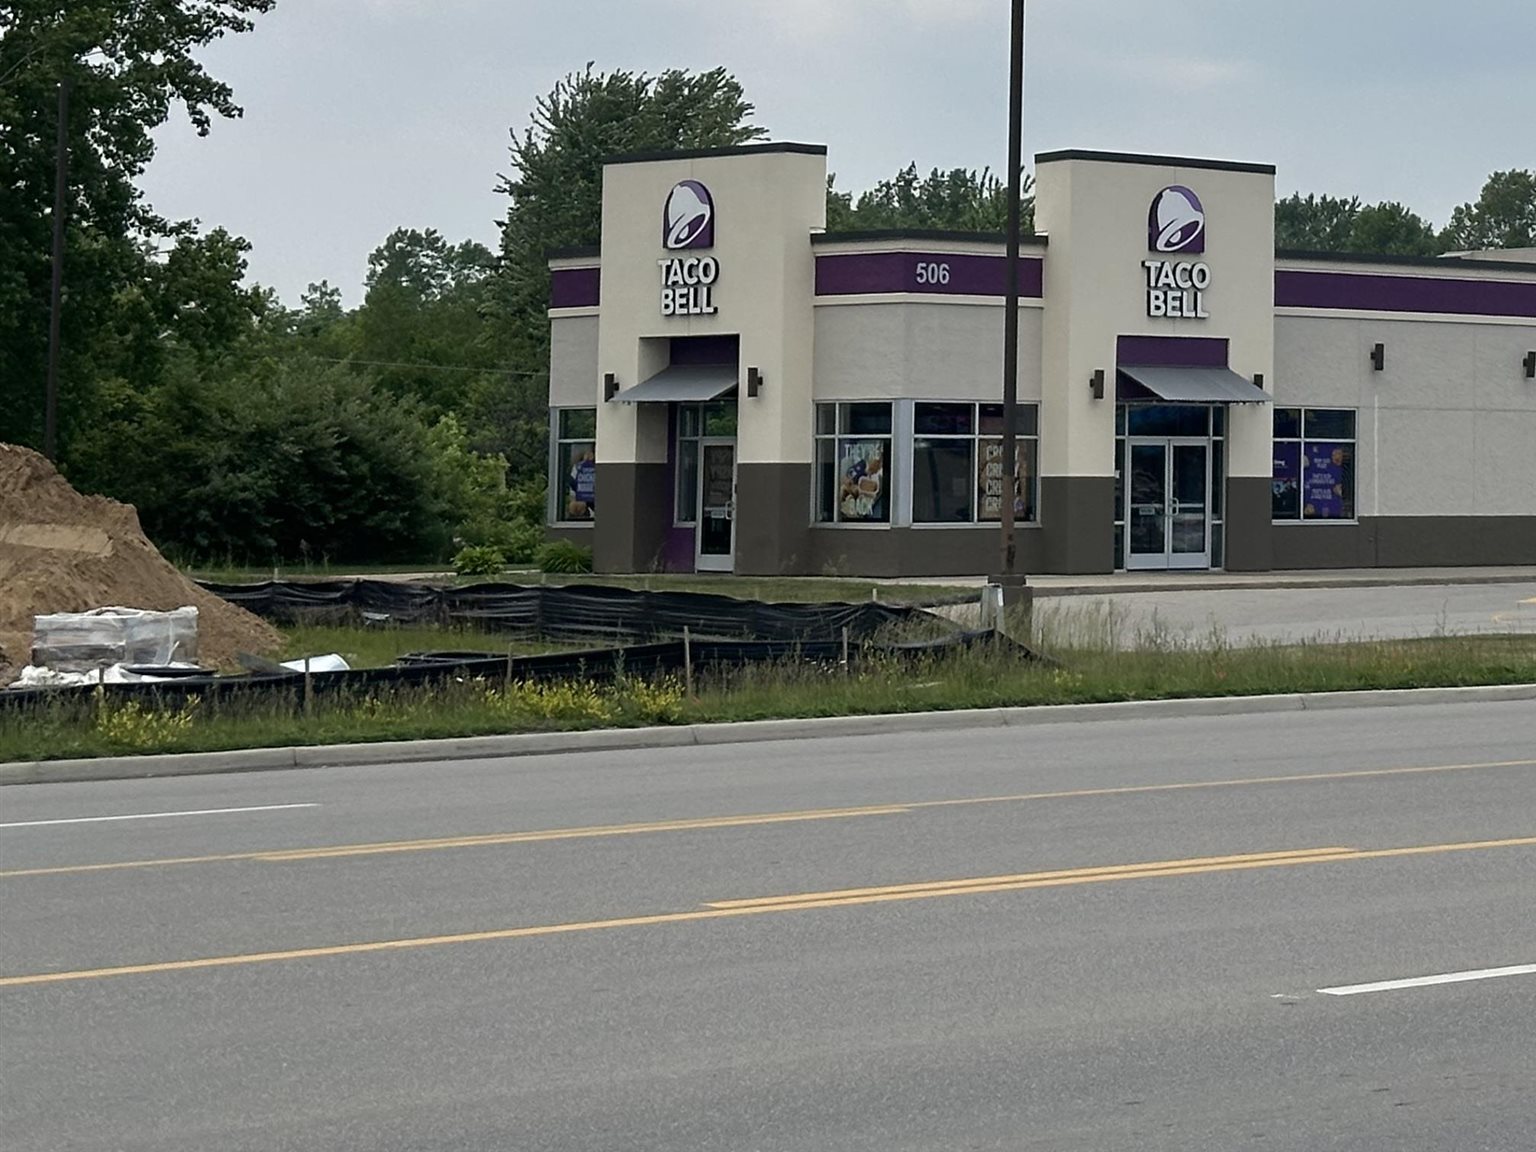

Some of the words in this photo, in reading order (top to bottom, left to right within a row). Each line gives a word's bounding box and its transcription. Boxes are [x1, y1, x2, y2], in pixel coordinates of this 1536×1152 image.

[657, 257, 719, 285] TACO
[916, 262, 950, 284] 506
[1142, 261, 1211, 289] TACO
[661, 287, 717, 315] BELL
[1147, 290, 1209, 318] BELL
